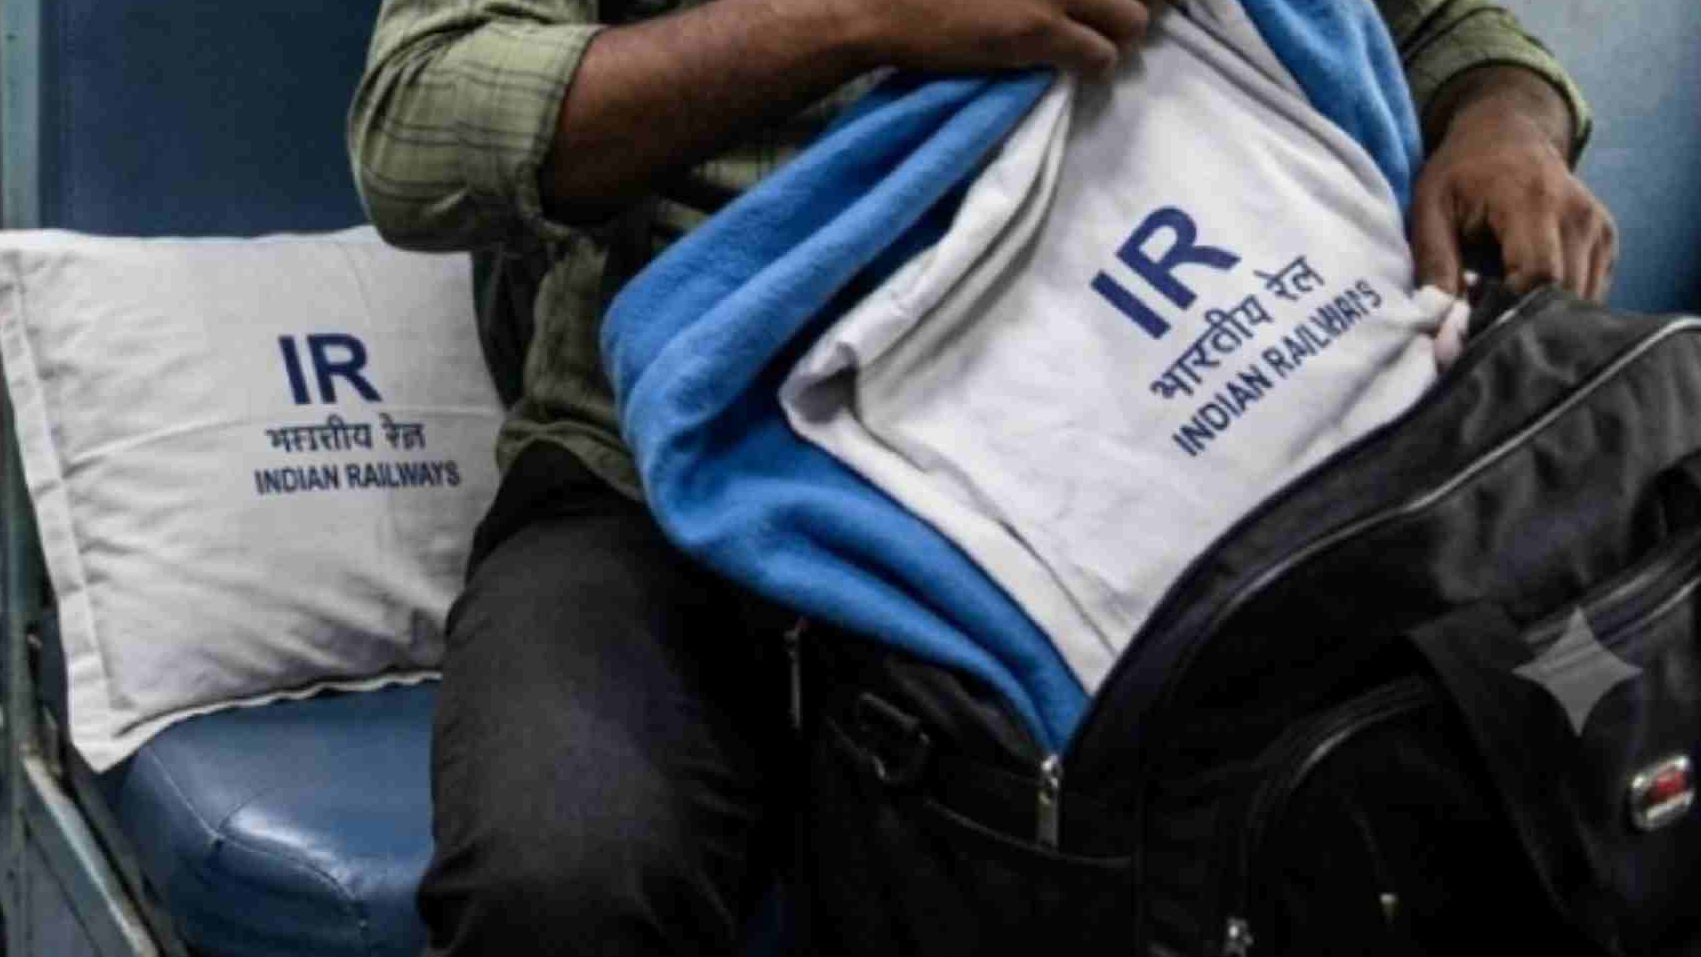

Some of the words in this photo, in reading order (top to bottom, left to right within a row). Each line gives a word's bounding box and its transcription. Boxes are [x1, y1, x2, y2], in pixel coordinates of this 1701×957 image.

[1090, 205, 1242, 340] IR
[1149, 295, 1273, 399] भारतीय
[1253, 256, 1325, 301] रेल
[278, 333, 384, 405] IR
[1171, 364, 1274, 458] INDIAN
[1261, 280, 1382, 378] RAILWAYS
[254, 464, 340, 495] INDIAN
[345, 460, 462, 490] RAILWAYS
